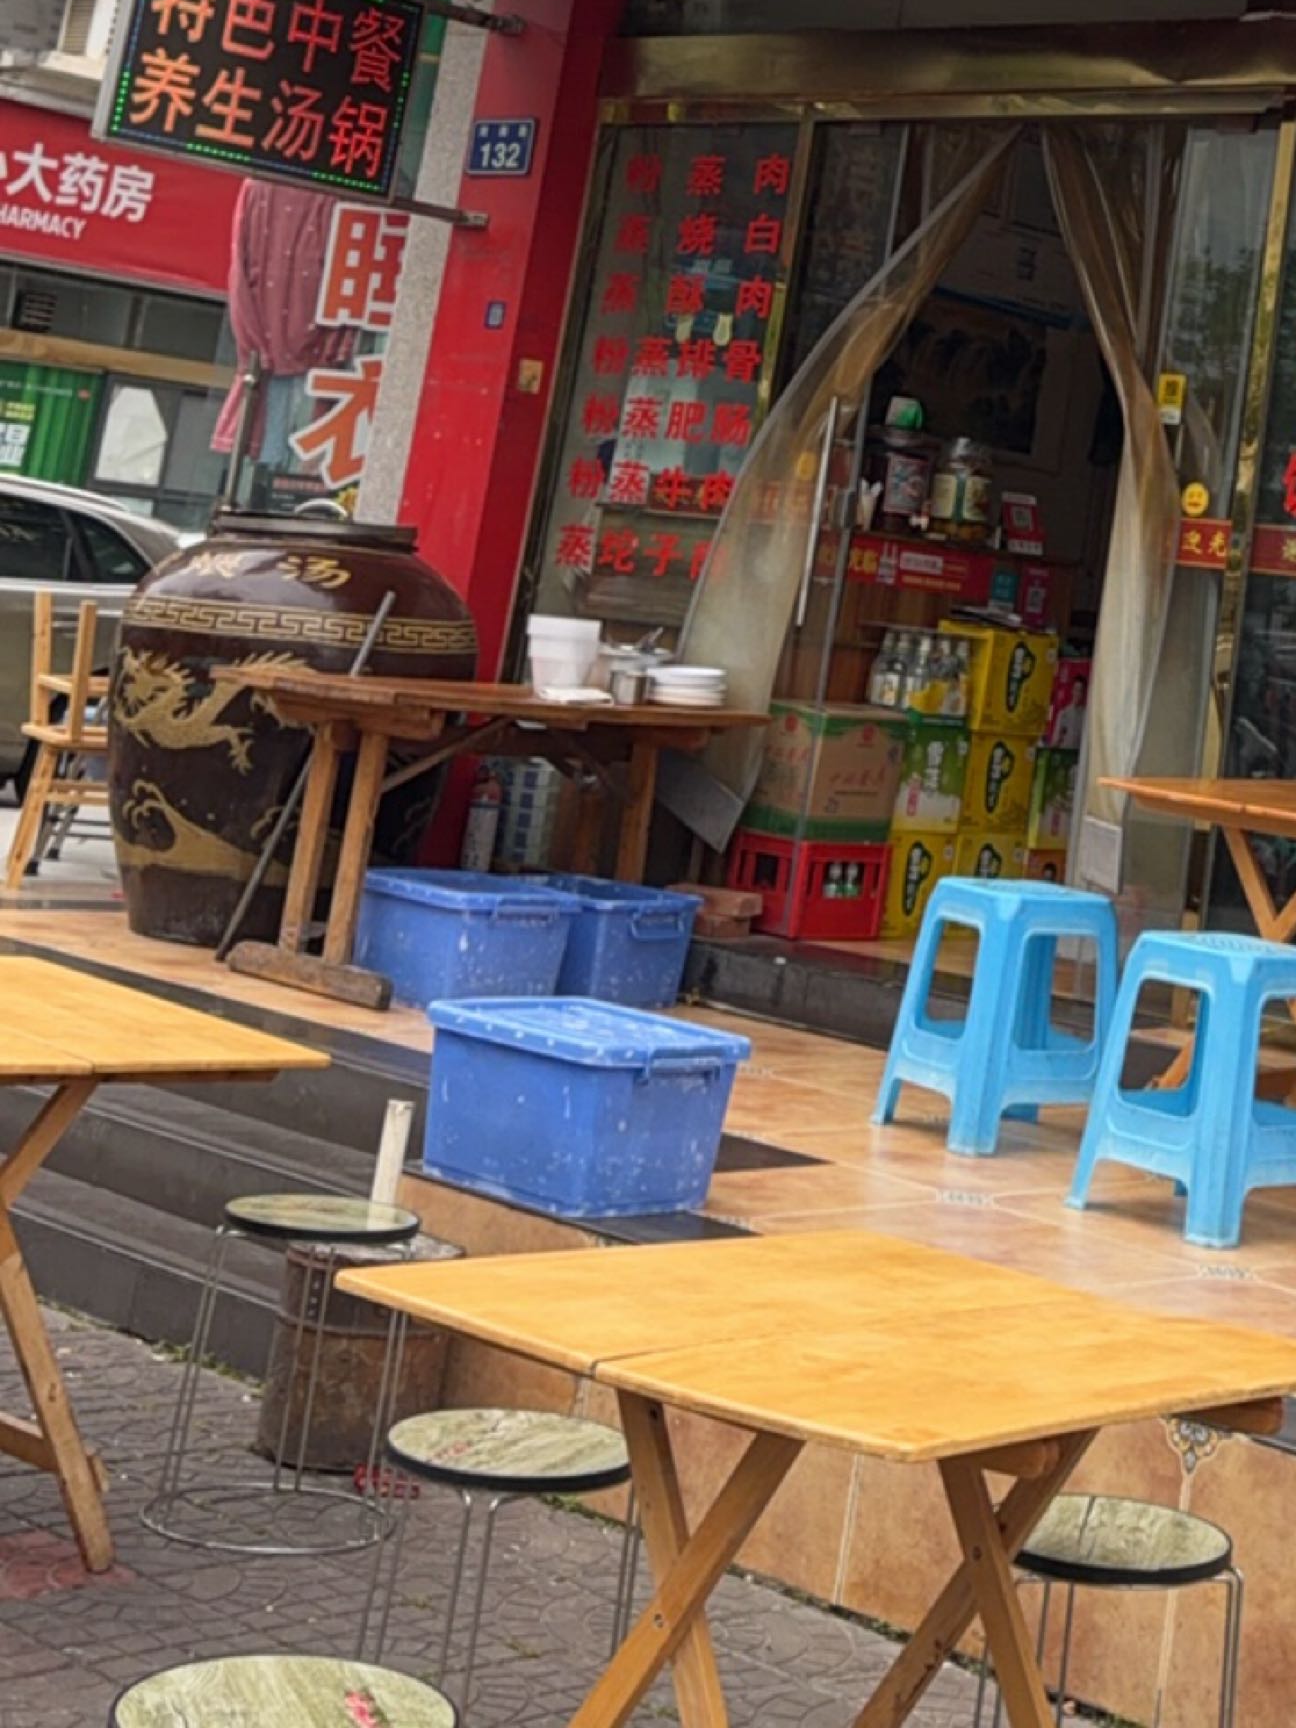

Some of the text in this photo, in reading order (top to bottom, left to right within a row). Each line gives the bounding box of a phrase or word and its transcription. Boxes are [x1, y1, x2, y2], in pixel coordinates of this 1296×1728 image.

[129, 47, 388, 179] 养生汤锅
[0, 142, 155, 223] 大药房
[480, 142, 521, 169] 132
